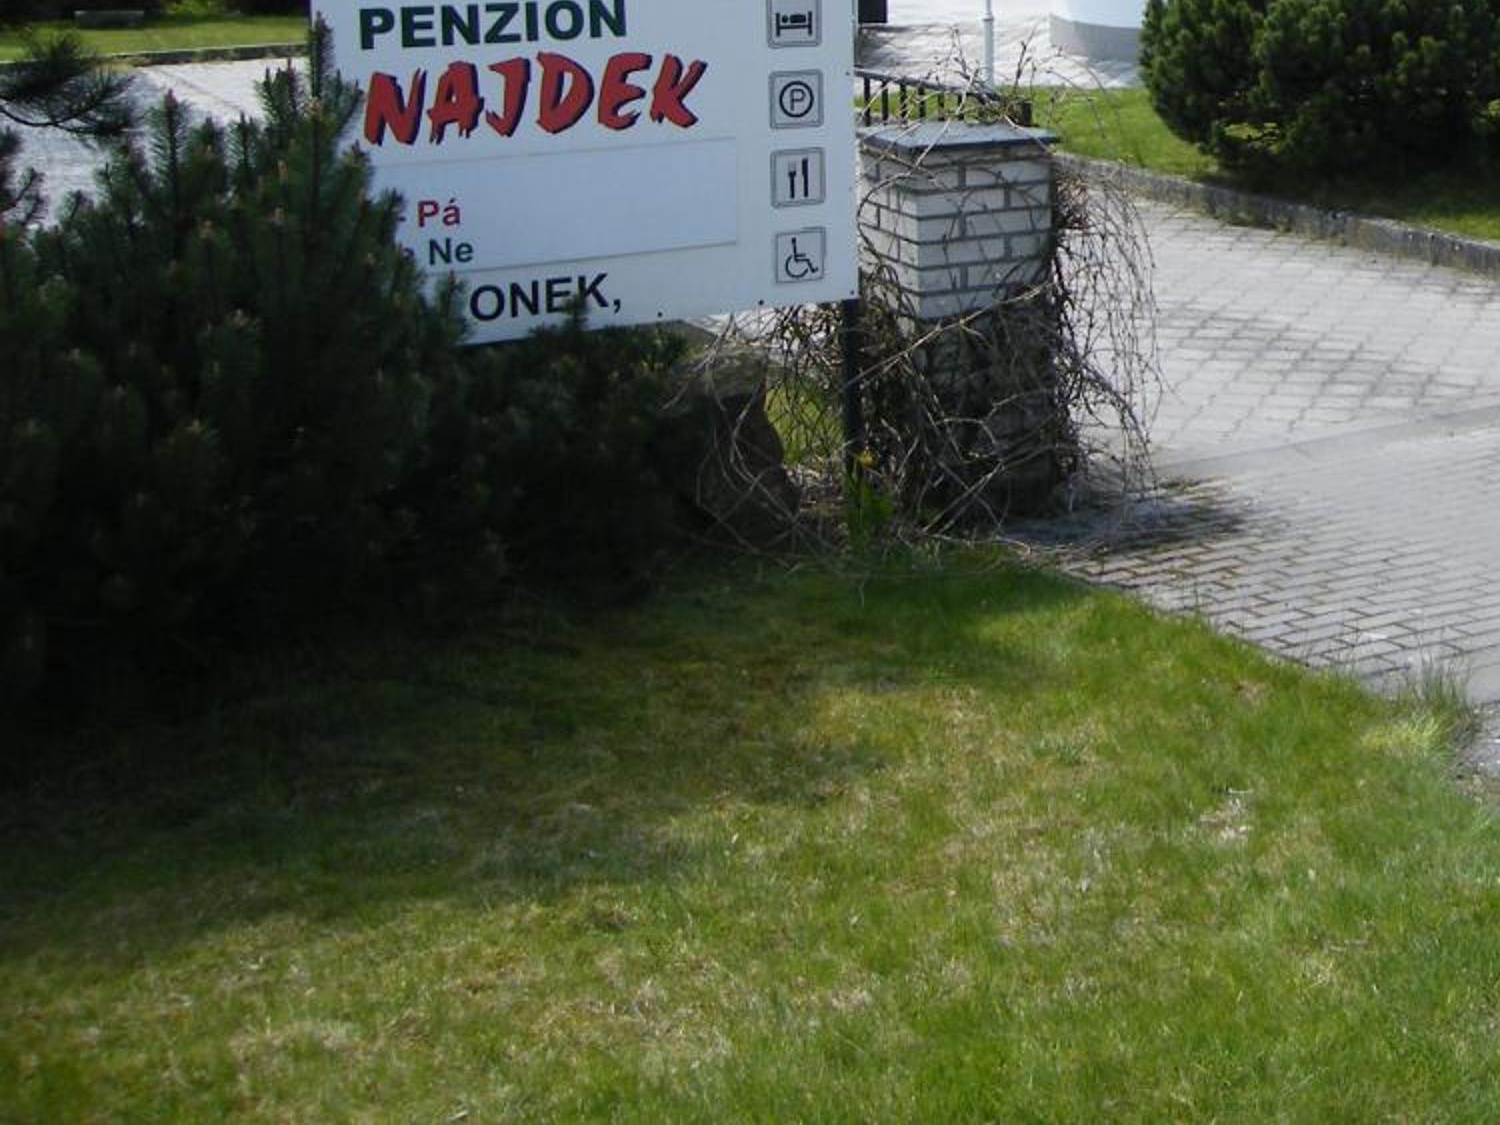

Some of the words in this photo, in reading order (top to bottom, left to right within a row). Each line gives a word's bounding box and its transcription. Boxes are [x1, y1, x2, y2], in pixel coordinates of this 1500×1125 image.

[364, 51, 707, 146] NAJDEK
[417, 197, 461, 227] Pá
[429, 237, 474, 266] Ne
[470, 272, 622, 321] ONEK,
